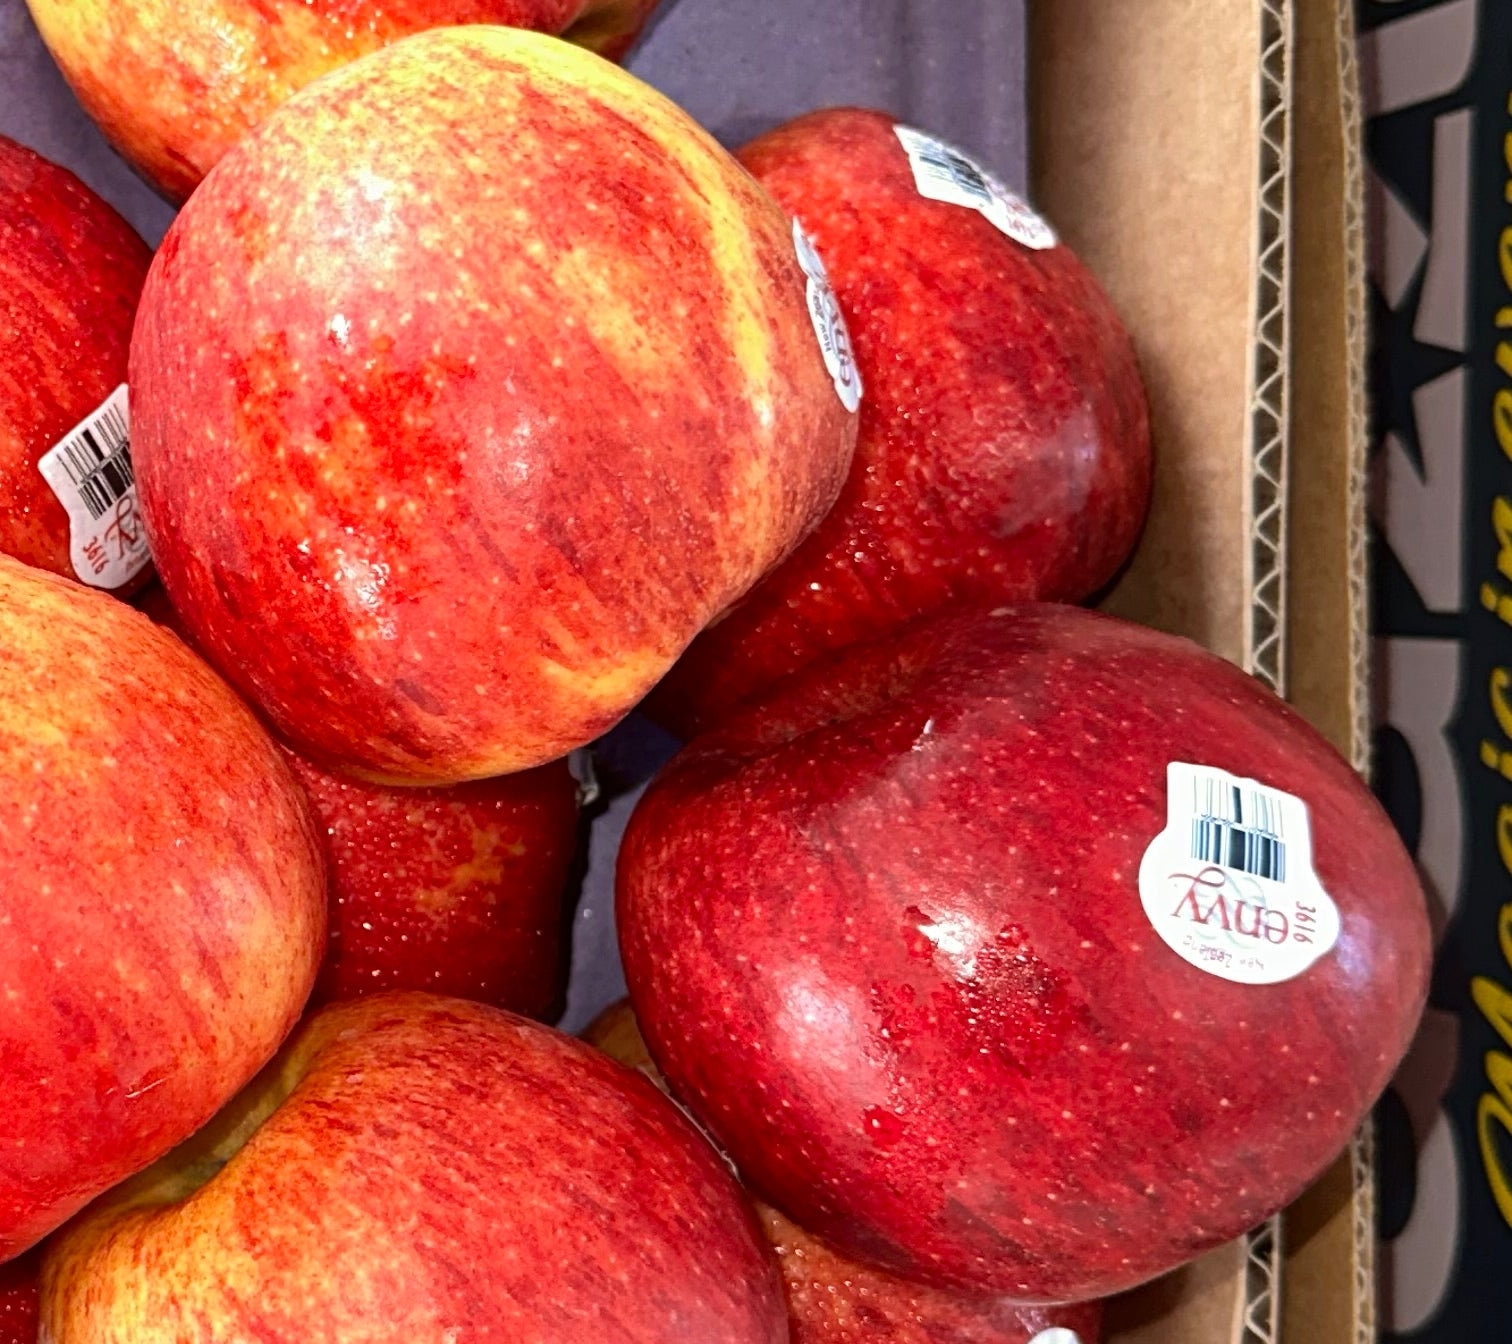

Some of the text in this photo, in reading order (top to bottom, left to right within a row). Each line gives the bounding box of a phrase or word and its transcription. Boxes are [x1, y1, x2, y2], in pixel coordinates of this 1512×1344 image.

[81, 534, 110, 575] 3616
[1167, 865, 1290, 946] envy
[1291, 900, 1318, 945] 3616
